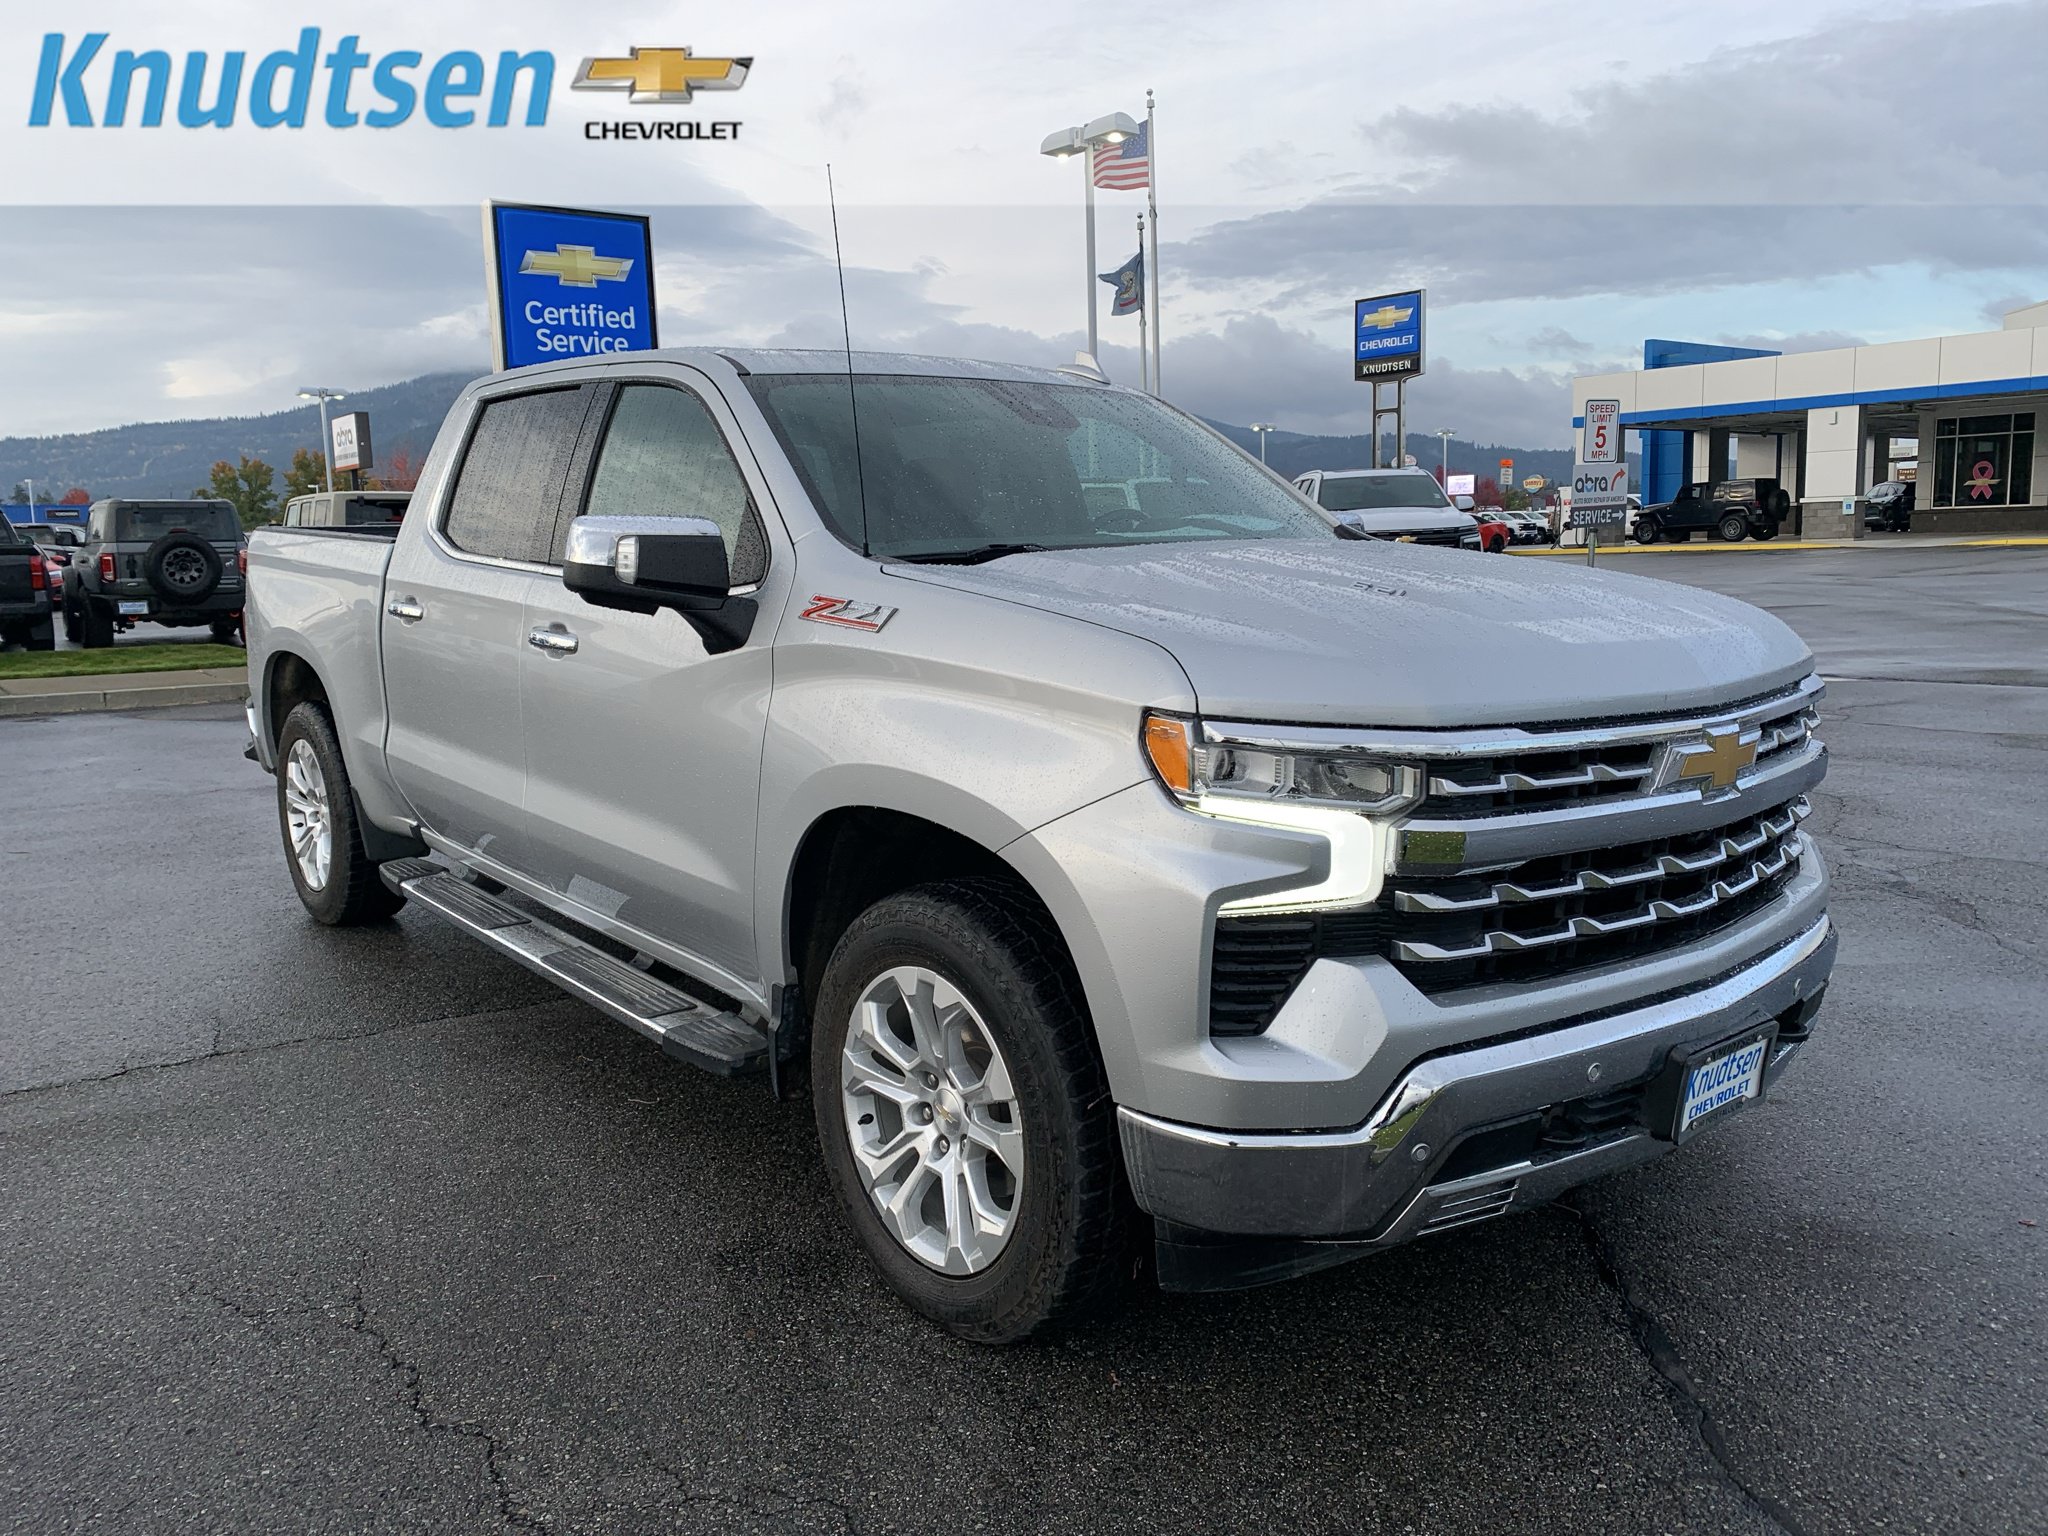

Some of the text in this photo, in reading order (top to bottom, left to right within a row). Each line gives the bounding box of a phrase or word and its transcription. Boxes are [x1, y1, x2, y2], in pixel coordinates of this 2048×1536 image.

[524, 300, 636, 330] Certified
[535, 328, 629, 355] Service
[1360, 334, 1415, 351] CHEVROLET
[1363, 359, 1411, 375] KNUDTSEN
[1589, 404, 1616, 413] SPEED
[1592, 414, 1613, 423] LIMIT
[1594, 425, 1607, 449] 5
[1591, 450, 1609, 459] MPH
[1574, 473, 1608, 493] abra
[1573, 509, 1612, 525] SERVICE
[798, 593, 899, 633] Z71
[1685, 1046, 1763, 1104] Knudtsen
[1688, 1078, 1751, 1120] CHEVROLET
